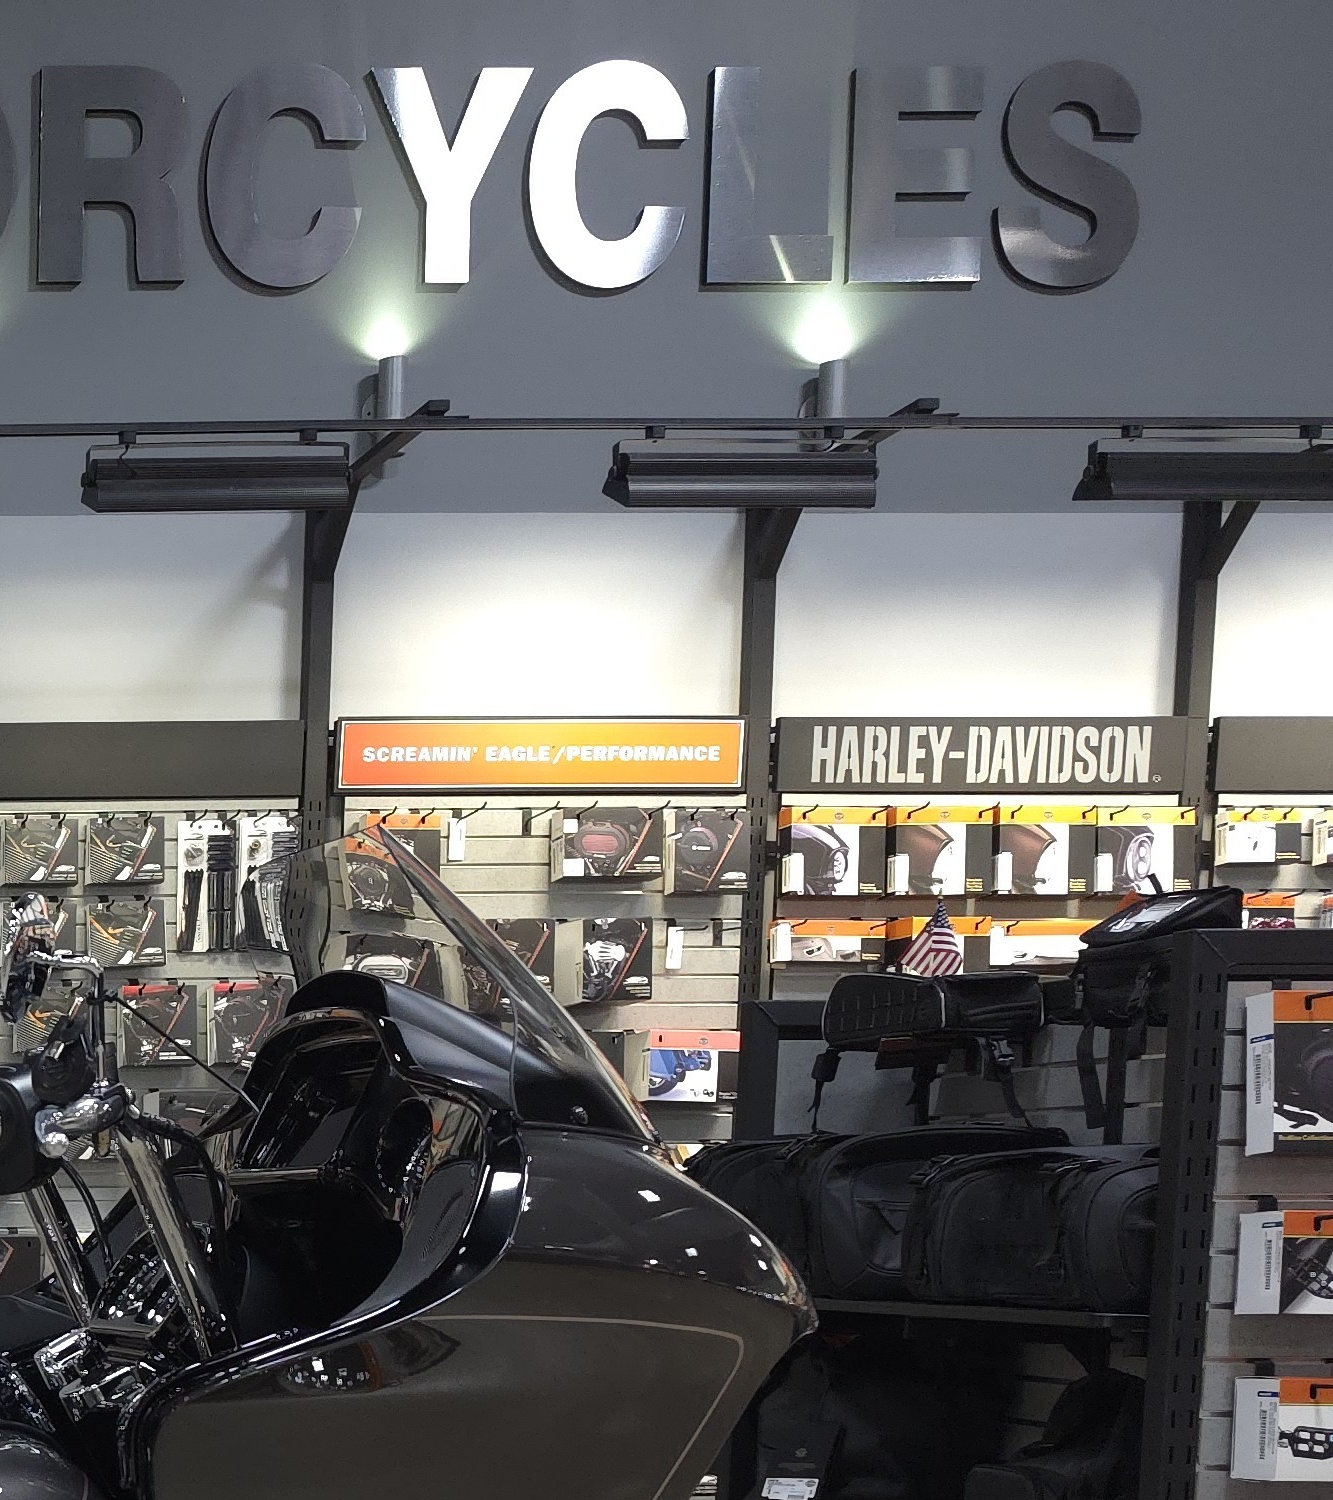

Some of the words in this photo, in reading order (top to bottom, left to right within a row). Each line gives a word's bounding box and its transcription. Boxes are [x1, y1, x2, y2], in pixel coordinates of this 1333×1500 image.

[362, 746, 478, 763] SCREAMIN'
[485, 745, 721, 765] EAGLE/PERFORMANCE
[810, 725, 1152, 784] HARLEY-DAVIDSON
